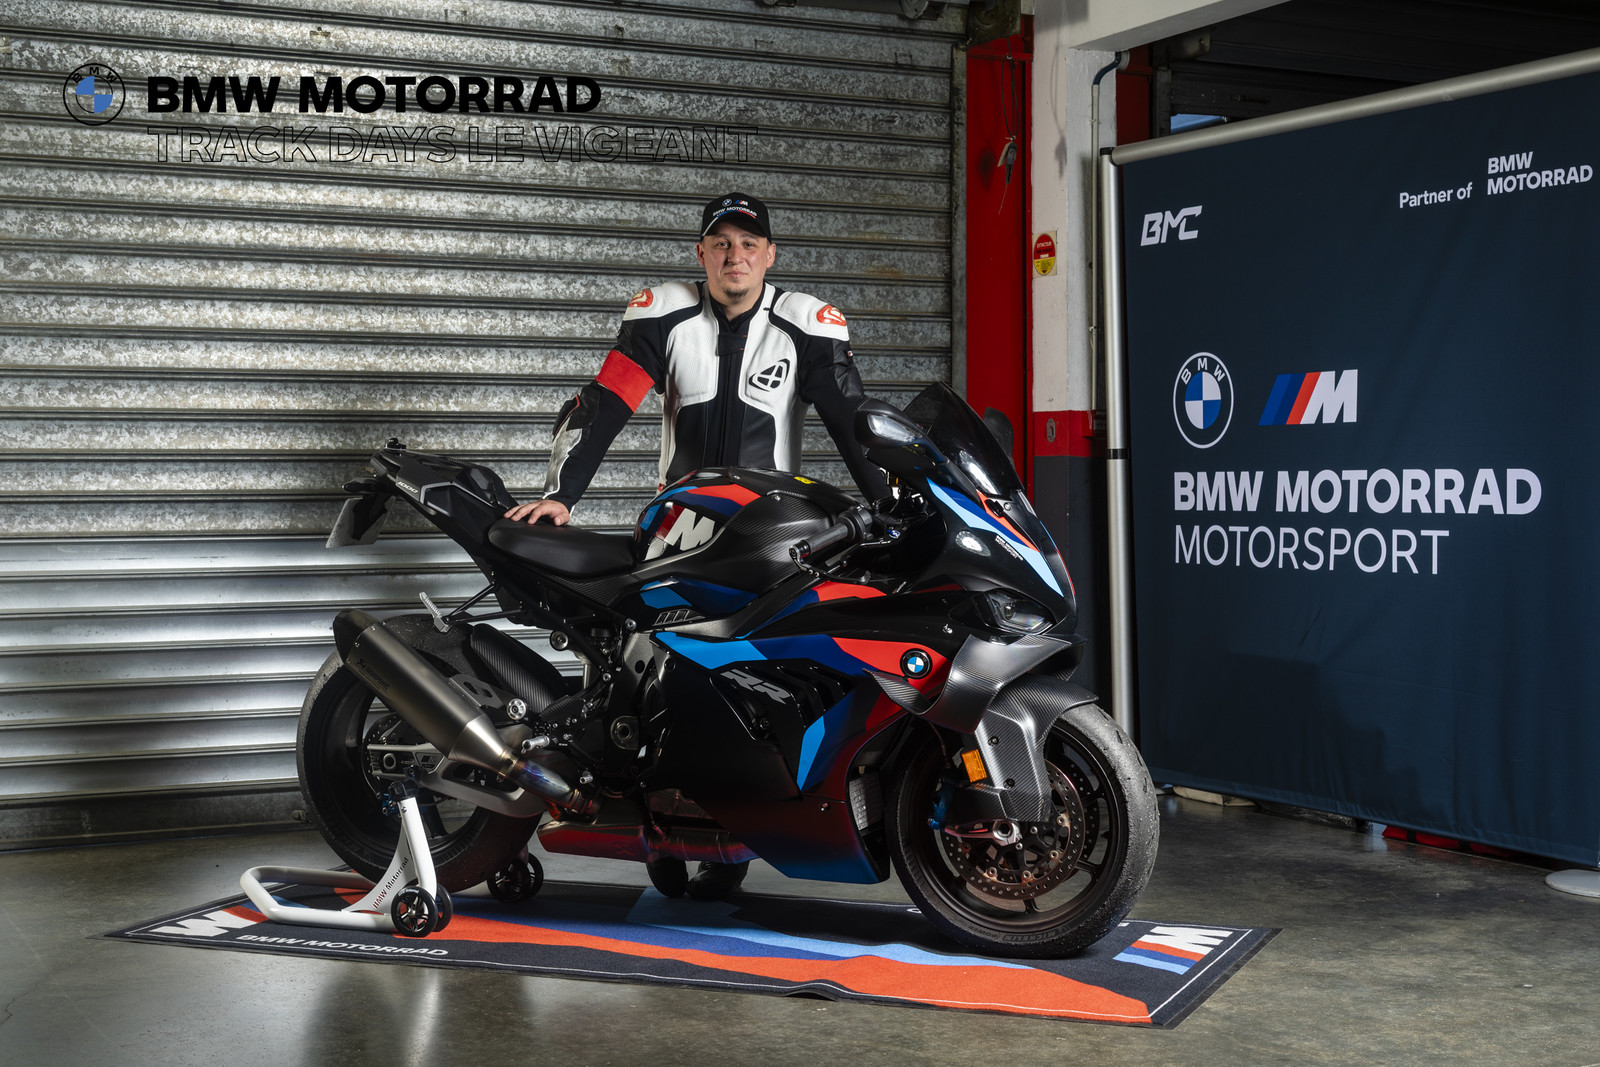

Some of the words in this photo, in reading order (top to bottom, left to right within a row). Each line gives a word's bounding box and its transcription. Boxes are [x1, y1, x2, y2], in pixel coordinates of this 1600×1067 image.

[1487, 151, 1534, 175] BMW
[1487, 164, 1593, 196] MOTORRAD
[1399, 184, 1454, 208] Partner
[1457, 182, 1473, 200] of
[1140, 205, 1202, 246] BMC
[1181, 357, 1225, 384] BMW
[1173, 470, 1264, 511] BMW
[1275, 468, 1542, 515] MOTORRAD
[1174, 524, 1450, 575] MOTORSPORT
[720, 668, 791, 705] RR
[372, 889, 388, 909] BMW
[385, 856, 409, 891] Motorrad
[236, 934, 304, 945] BMW
[303, 940, 449, 956] MOTORRAD
